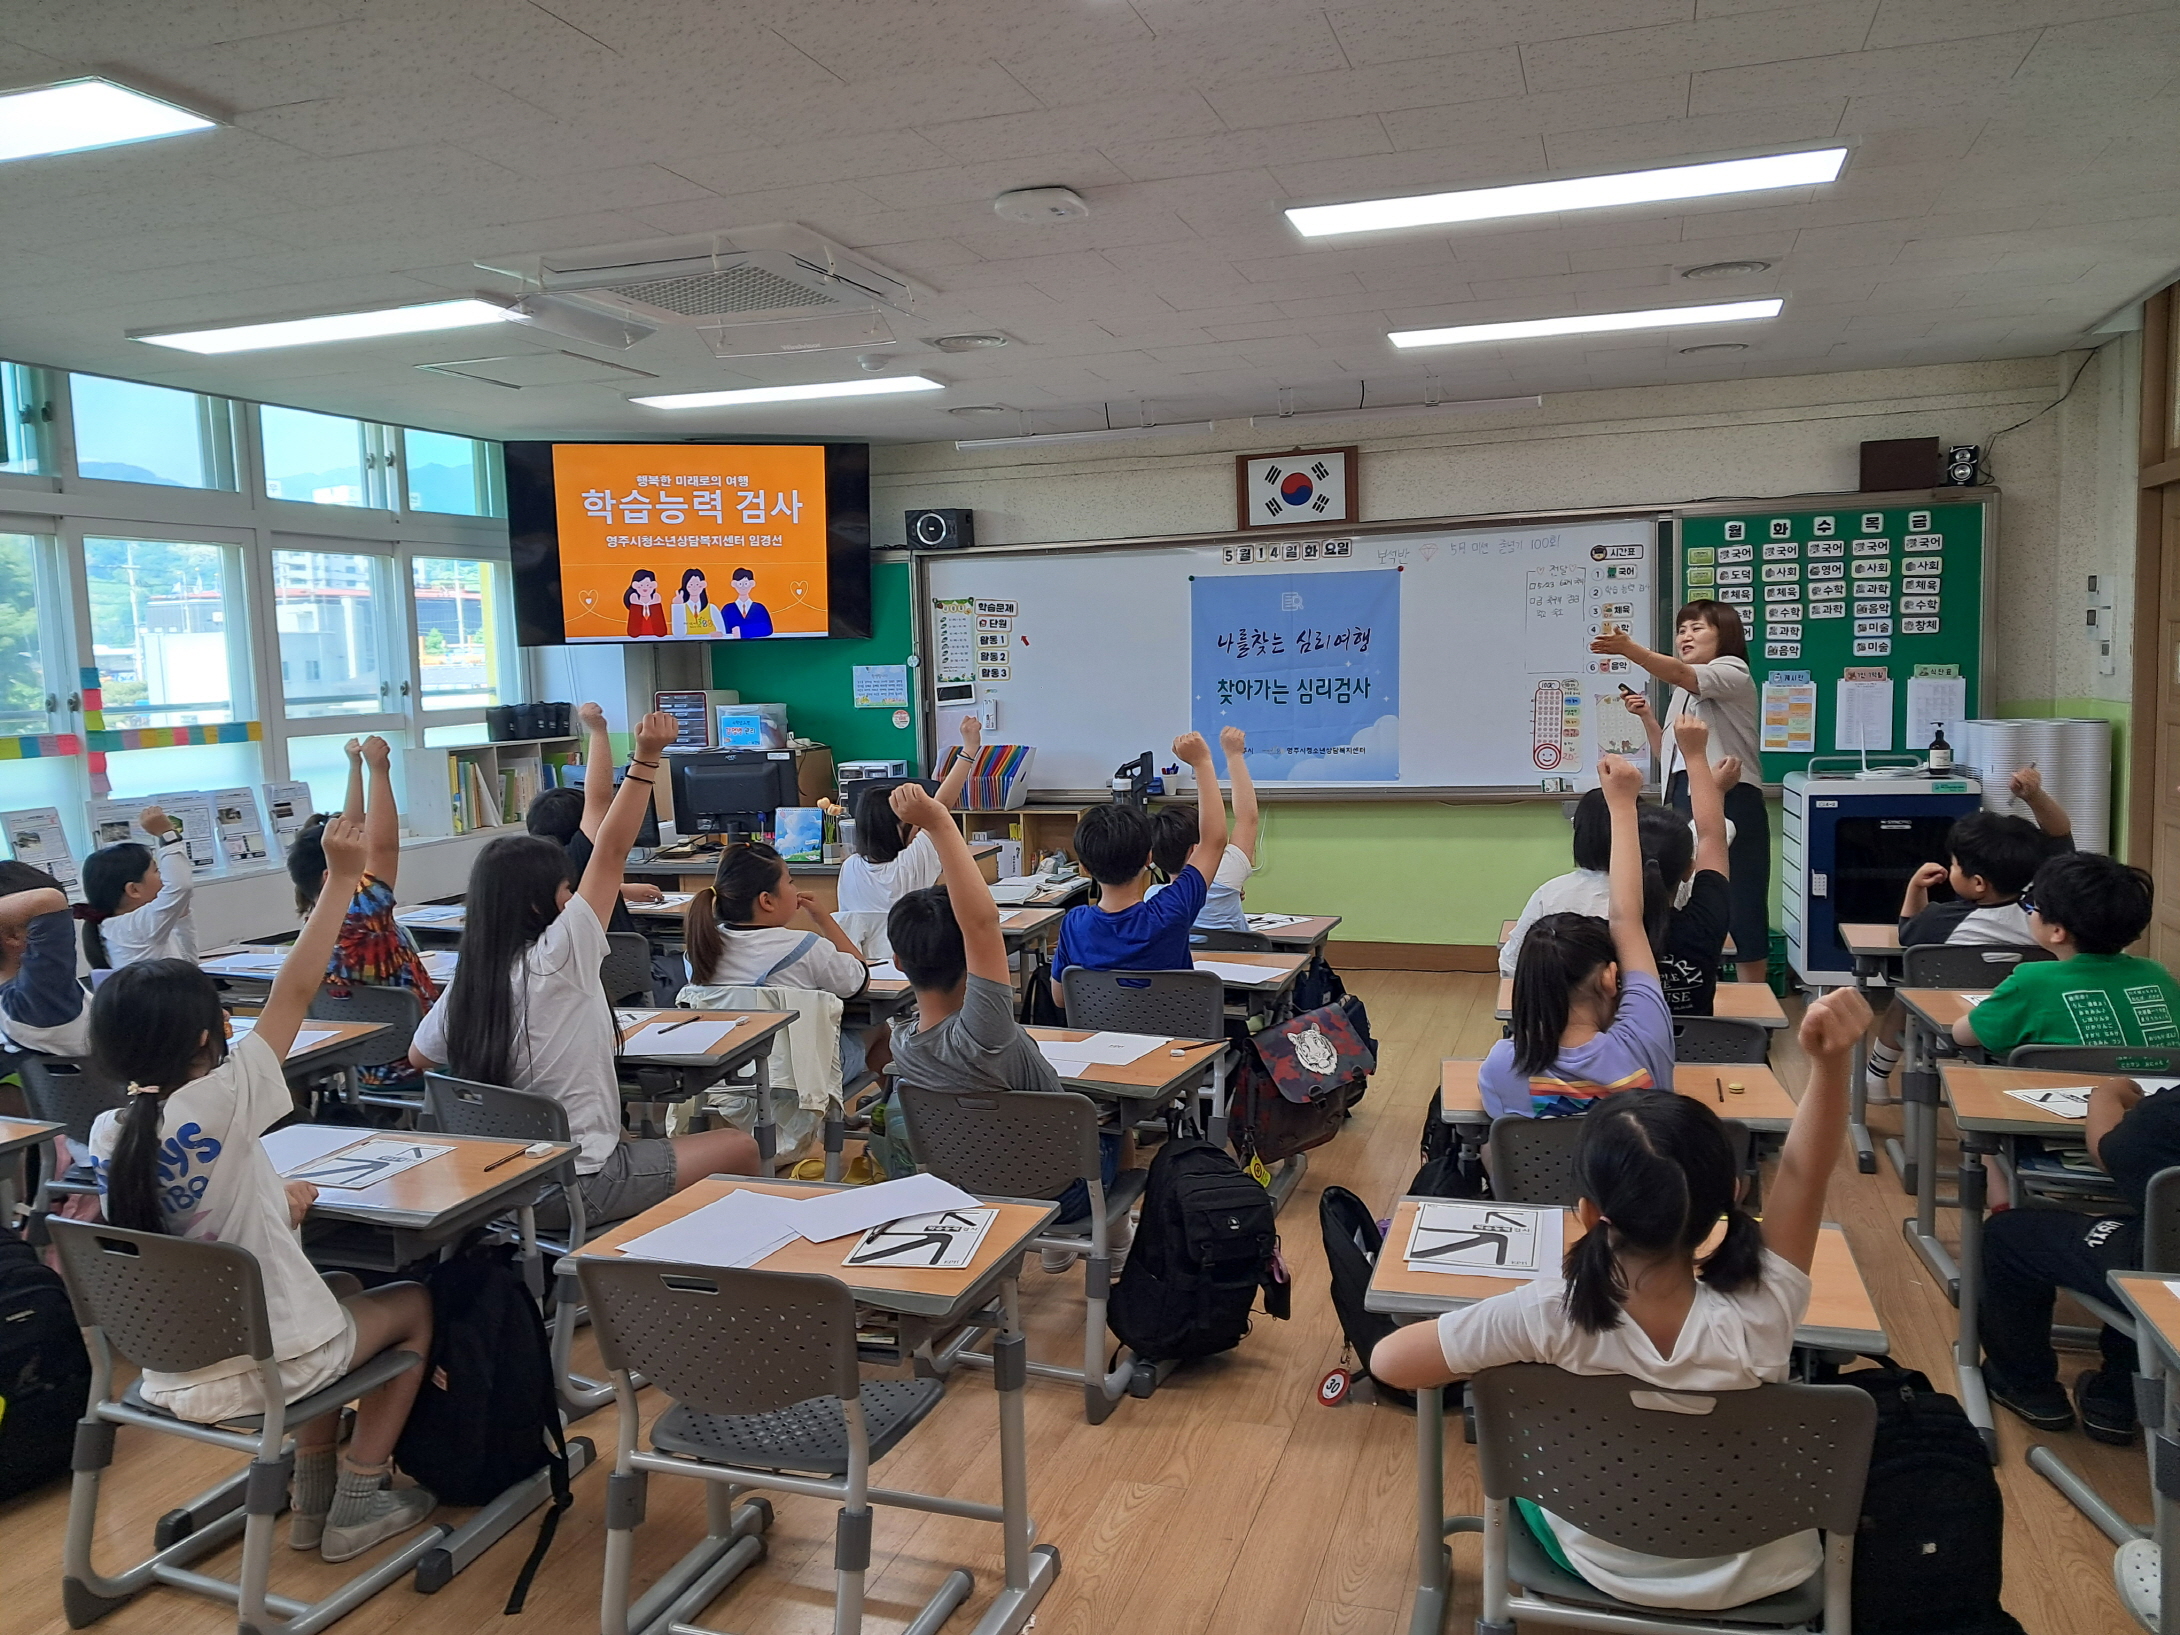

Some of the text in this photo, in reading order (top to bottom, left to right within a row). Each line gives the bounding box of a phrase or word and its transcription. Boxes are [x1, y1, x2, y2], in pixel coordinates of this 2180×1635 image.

[636, 474, 749, 487] 행복한 미래로의 여행
[581, 488, 804, 525] 학습능력 검사
[1728, 514, 1928, 538] 월 화 수 목 금
[606, 535, 783, 548] 영주시청소년상담복지센터 임경선
[1731, 537, 1942, 559] 국어 국어 국어 국어 국어
[1610, 547, 1636, 557] 시간표
[1618, 567, 1635, 576] 국어
[1731, 559, 1940, 581] 도덕 사회 영어 사회 사회
[1593, 588, 1599, 596] 2
[1730, 578, 1938, 601] 체육 체육 수학 과학 체육
[978, 602, 1014, 613] 학습문제
[1593, 605, 1631, 615] 3 체육
[1780, 607, 1801, 618] 수학
[1821, 603, 1844, 615] 과학
[1867, 602, 1889, 614] 음악
[1916, 598, 1938, 610] 수학
[989, 618, 1007, 629] 단원
[1779, 626, 1800, 637] 과학
[1868, 621, 1890, 633] 미술
[1915, 618, 1938, 631] 창체
[980, 635, 1005, 645] 활동 1
[1217, 626, 1372, 659] 나를찾는 심리여행
[1778, 641, 1889, 657] 음악 미술
[980, 652, 1006, 662] 활동 2
[1611, 661, 1628, 671] 음악
[1930, 668, 1952, 677] 식단표
[981, 668, 1007, 678] 활동 3
[1217, 676, 1372, 705] 찾아가는 심리검사
[1326, 1378, 1341, 1394] 30
